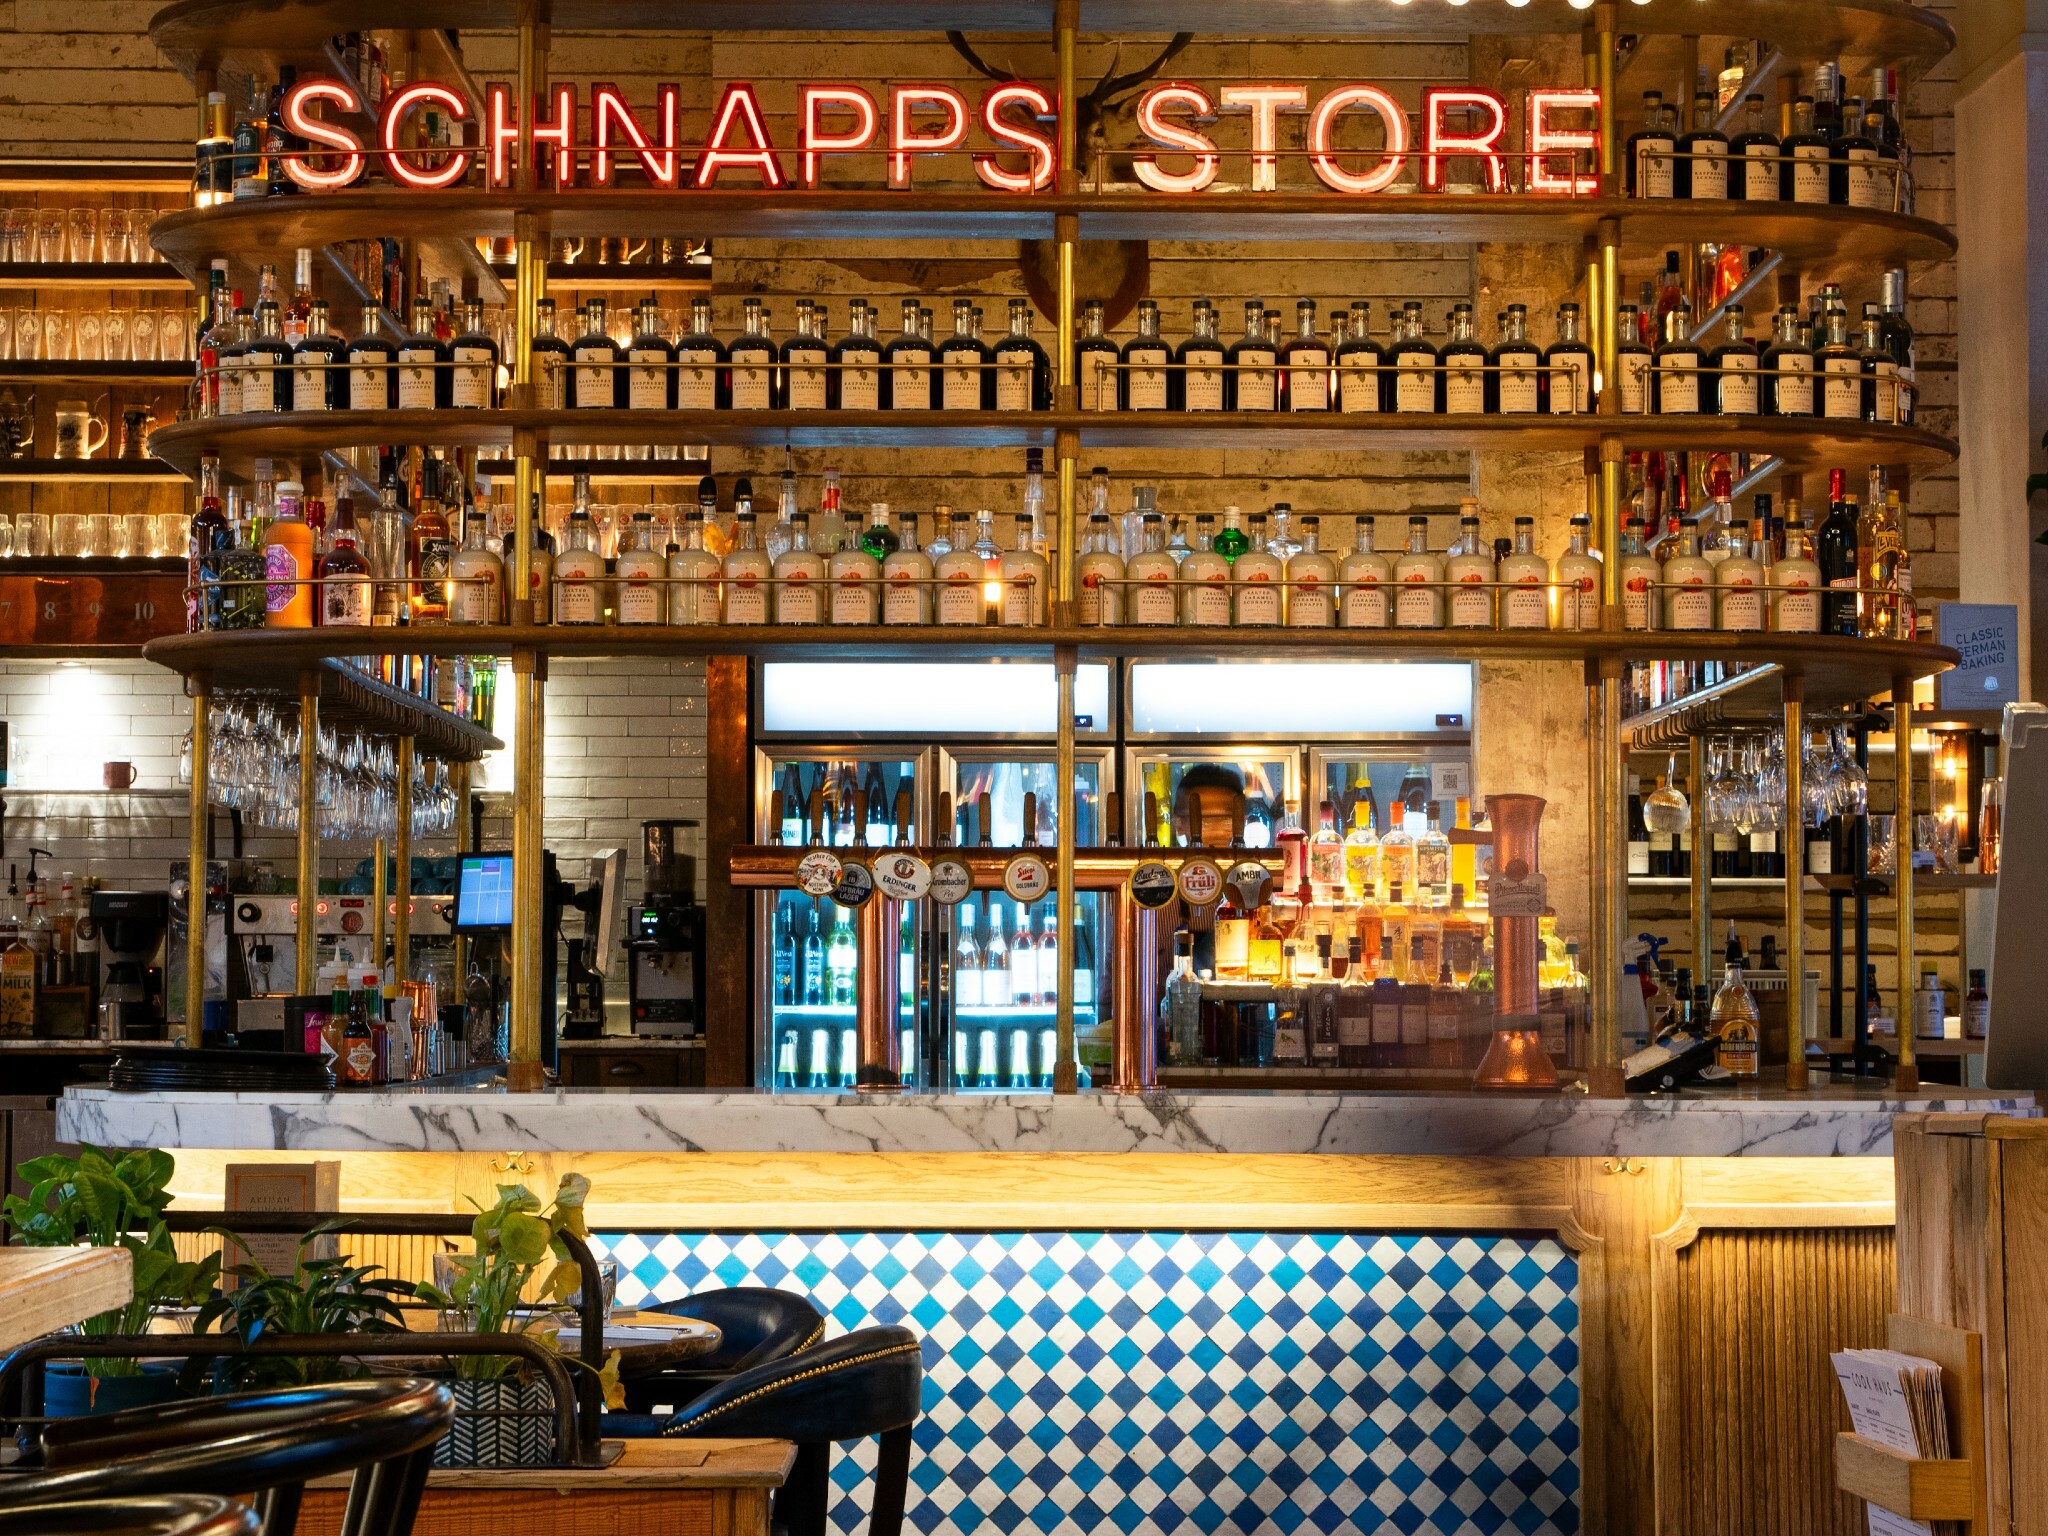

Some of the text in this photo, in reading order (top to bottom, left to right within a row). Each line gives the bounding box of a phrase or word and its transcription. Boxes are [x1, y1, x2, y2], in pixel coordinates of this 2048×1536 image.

[280, 79, 1601, 195] SCHNAPPS STORE
[0, 602, 154, 620] 7 8 9 10
[1956, 627, 2004, 644] CLASSIC
[1957, 640, 2006, 657] GERMAN
[1961, 652, 2004, 670] BAKING
[882, 874, 916, 892] ERDINGER
[932, 877, 966, 886] Krombacher
[1186, 876, 1214, 888] Früli
[1236, 870, 1262, 882] AMBR
[838, 886, 865, 896] OFBRÄU
[840, 892, 860, 901] LAGER
[3, 979, 32, 990] MILK
[250, 1196, 290, 1204] ARTISAN
[1851, 1372, 1892, 1396] COOK HAUS
